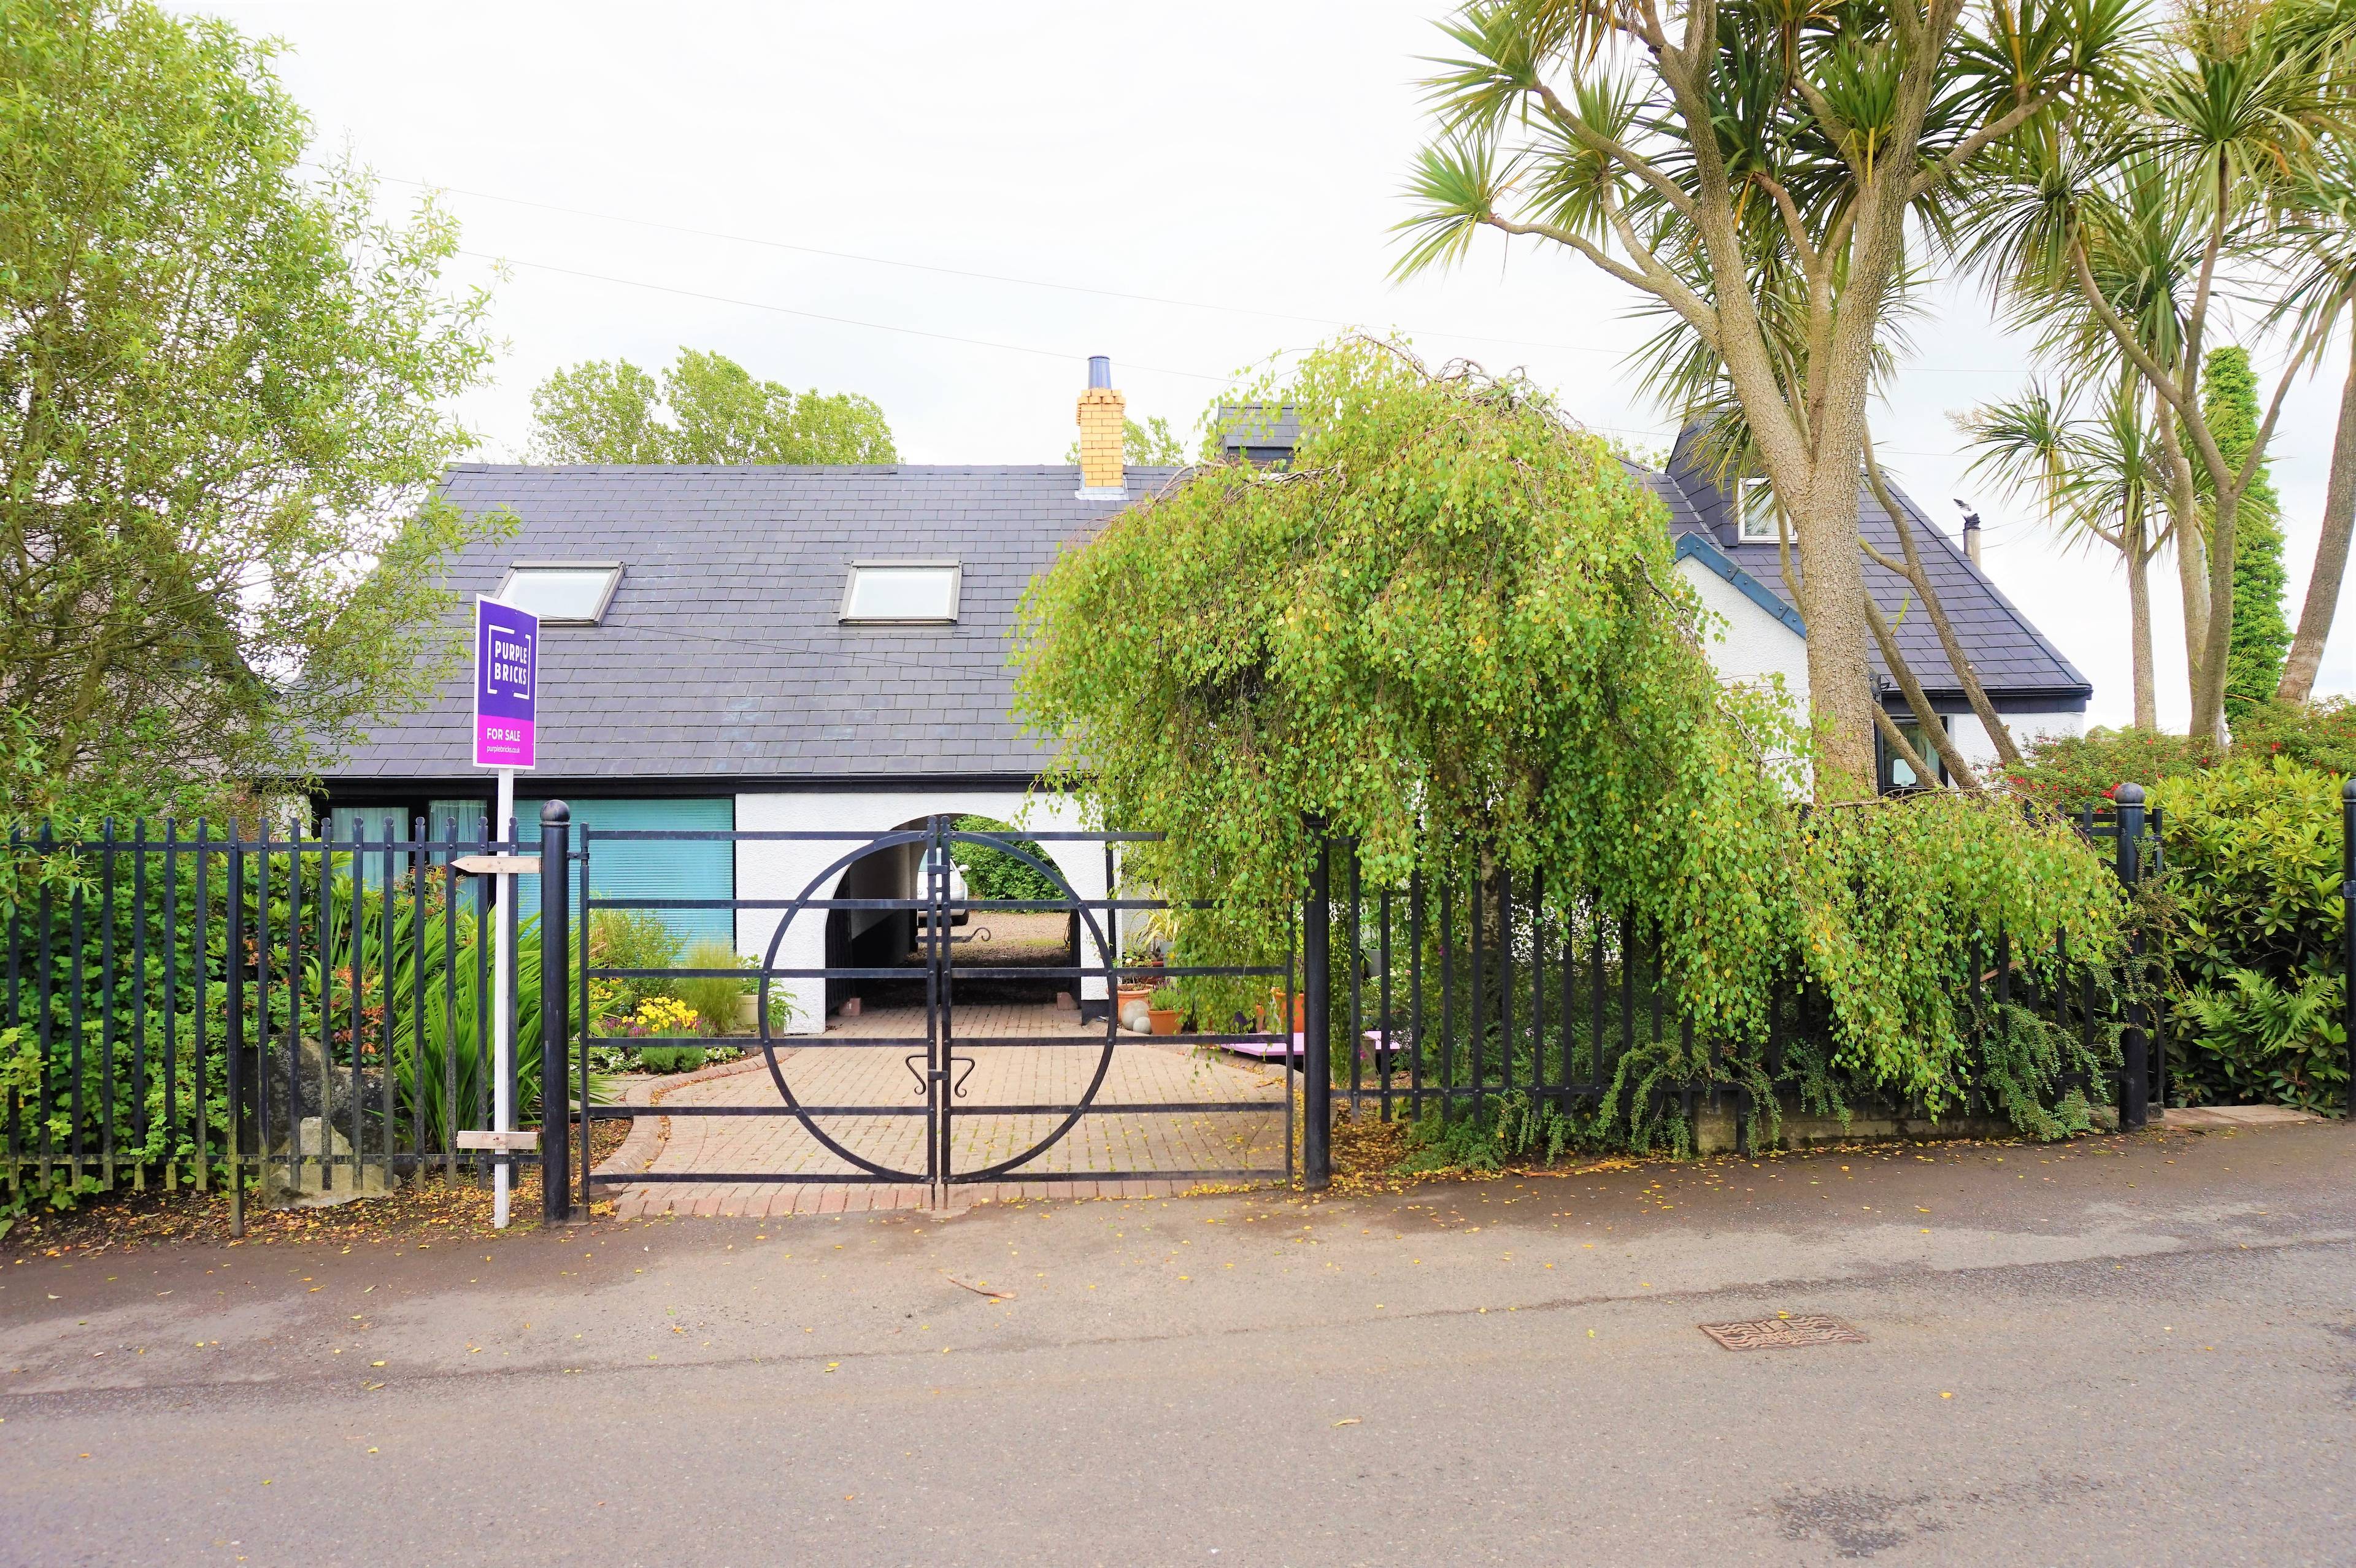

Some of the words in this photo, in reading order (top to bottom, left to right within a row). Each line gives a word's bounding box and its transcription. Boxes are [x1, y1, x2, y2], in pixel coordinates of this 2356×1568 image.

[495, 640, 527, 664] PURPLE
[494, 662, 526, 685] BRICKS
[487, 728, 503, 740] FOR
[505, 729, 520, 742] SALE
